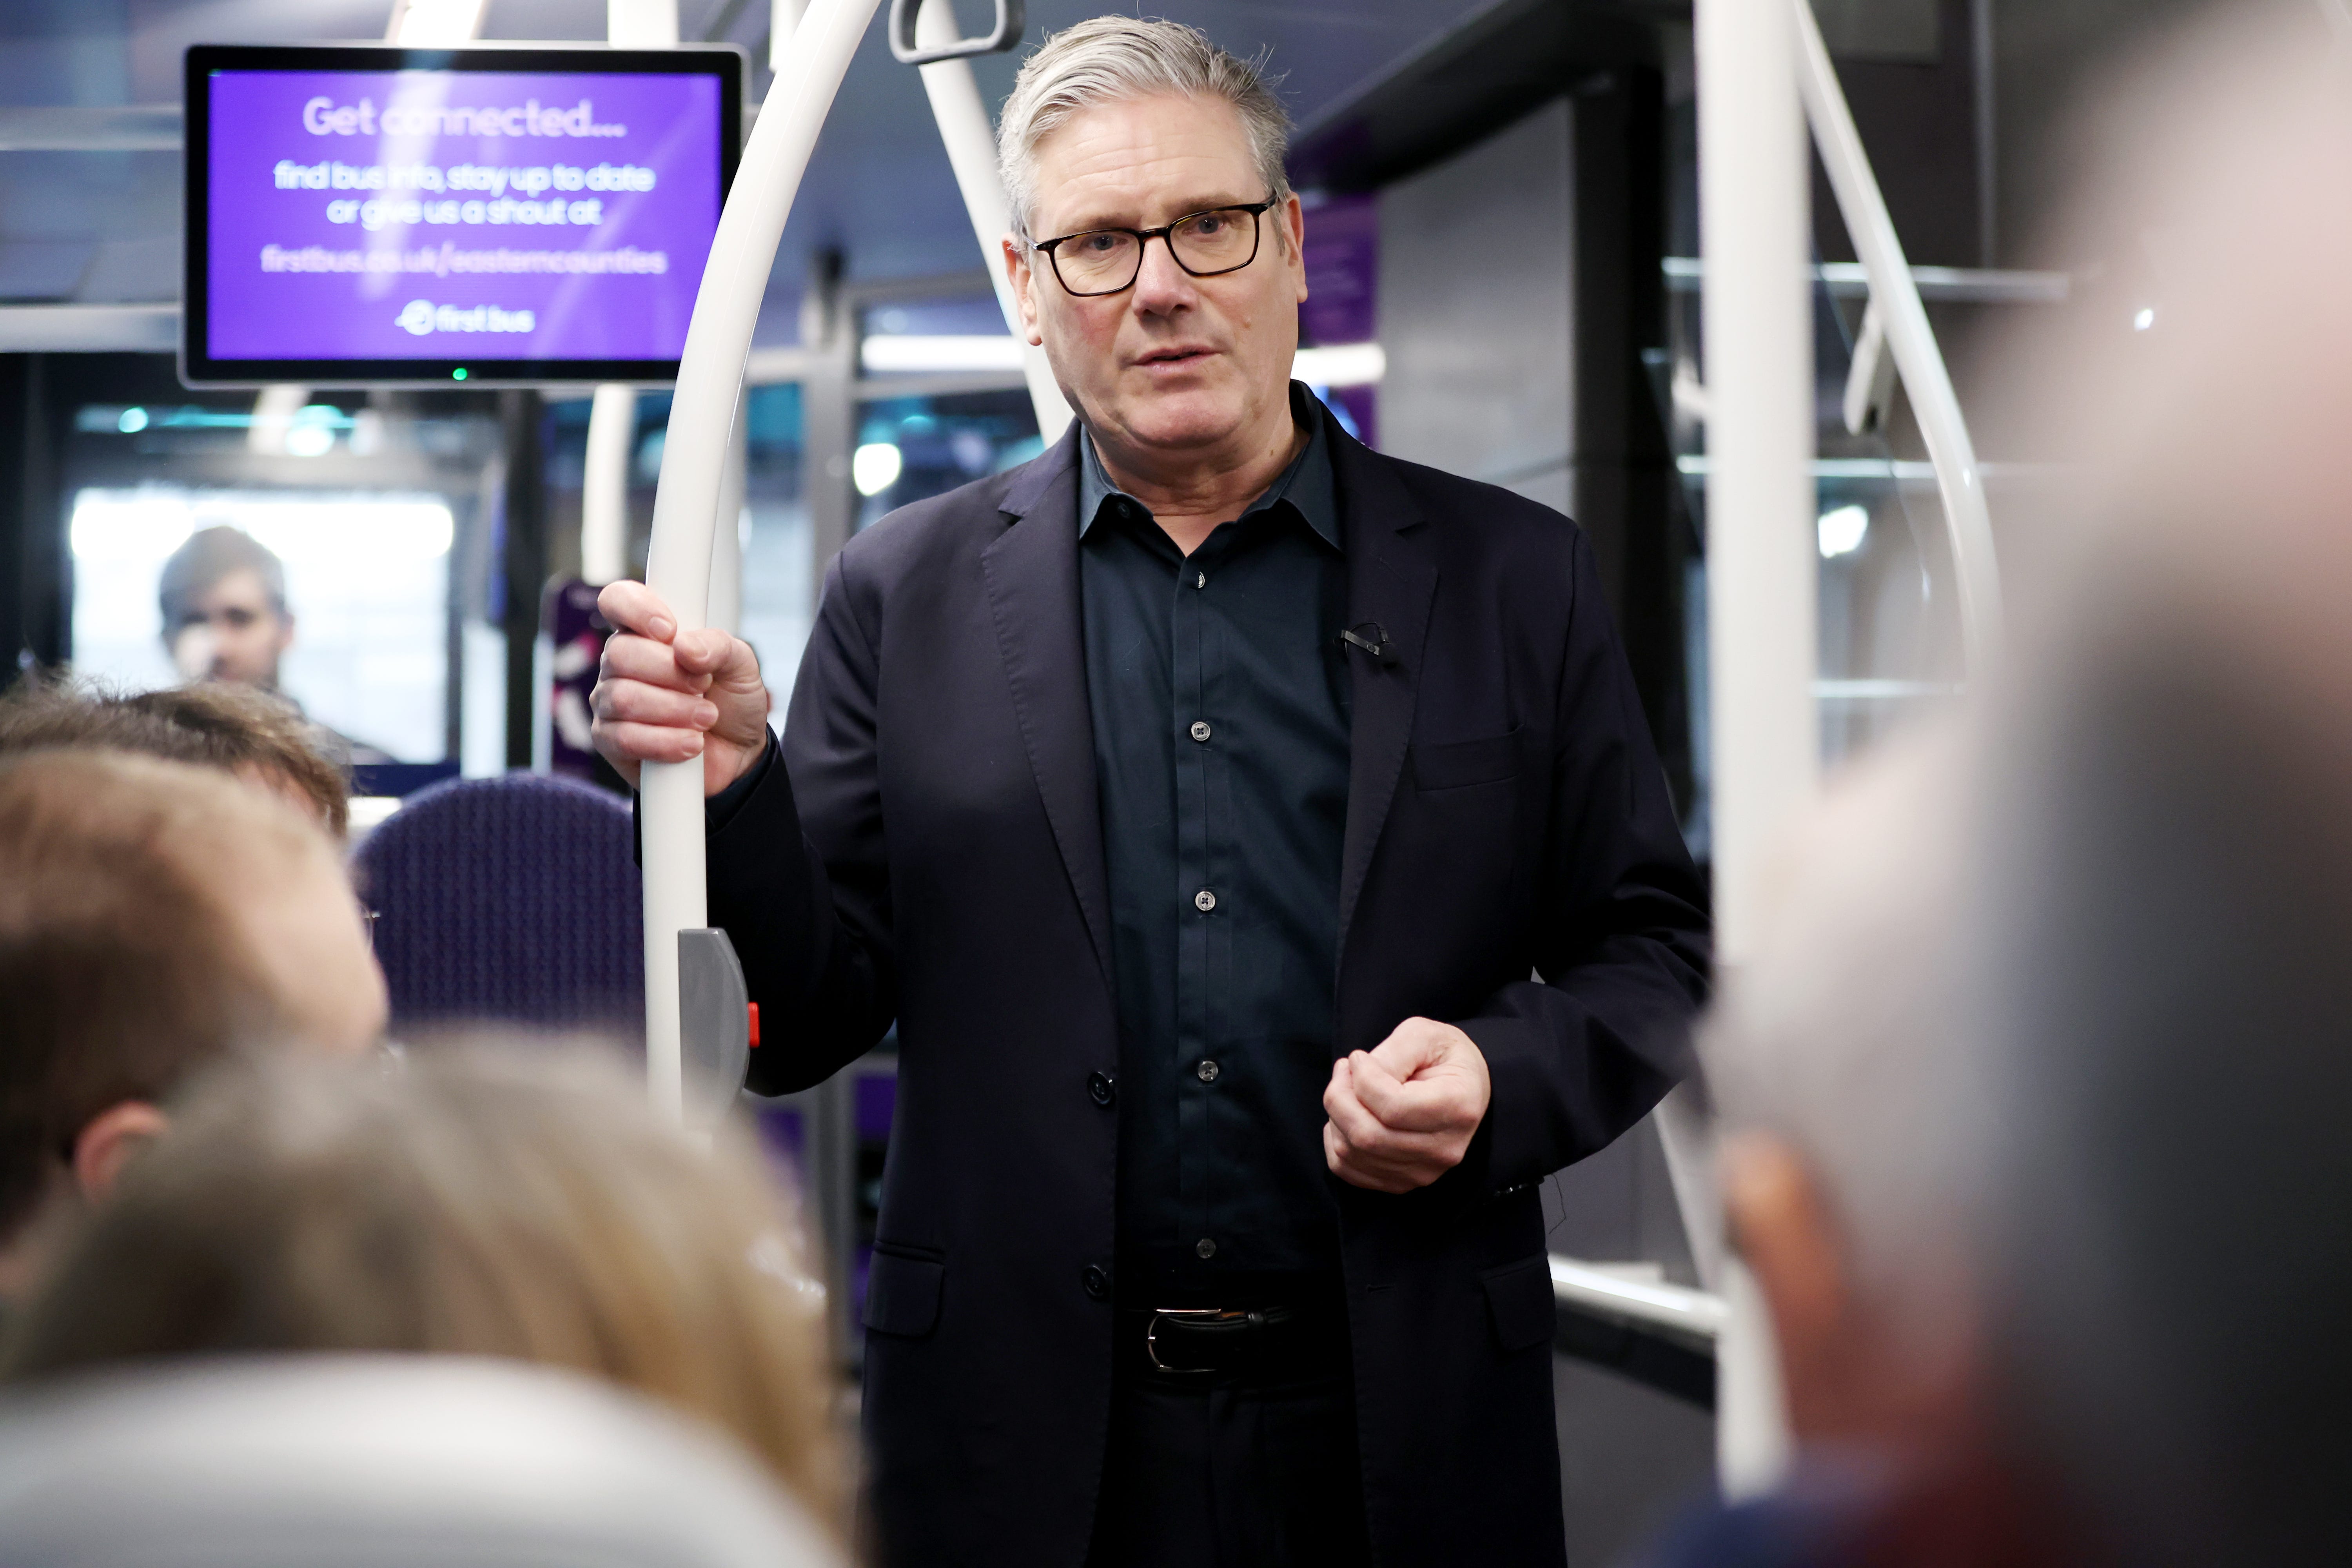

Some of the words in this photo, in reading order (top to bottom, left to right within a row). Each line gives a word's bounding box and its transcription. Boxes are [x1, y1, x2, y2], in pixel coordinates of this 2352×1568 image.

[303, 96, 377, 136] Get
[273, 160, 330, 189] find
[331, 160, 387, 190] bus
[446, 163, 510, 198] stay
[510, 166, 552, 198] up
[553, 163, 586, 191] to
[585, 162, 657, 192] date
[326, 199, 362, 224] or
[360, 196, 423, 231] give
[423, 200, 462, 224] us
[461, 200, 486, 224] a
[486, 196, 567, 225] shout
[567, 197, 604, 225] at
[436, 304, 487, 332] first
[487, 304, 535, 333] bus
